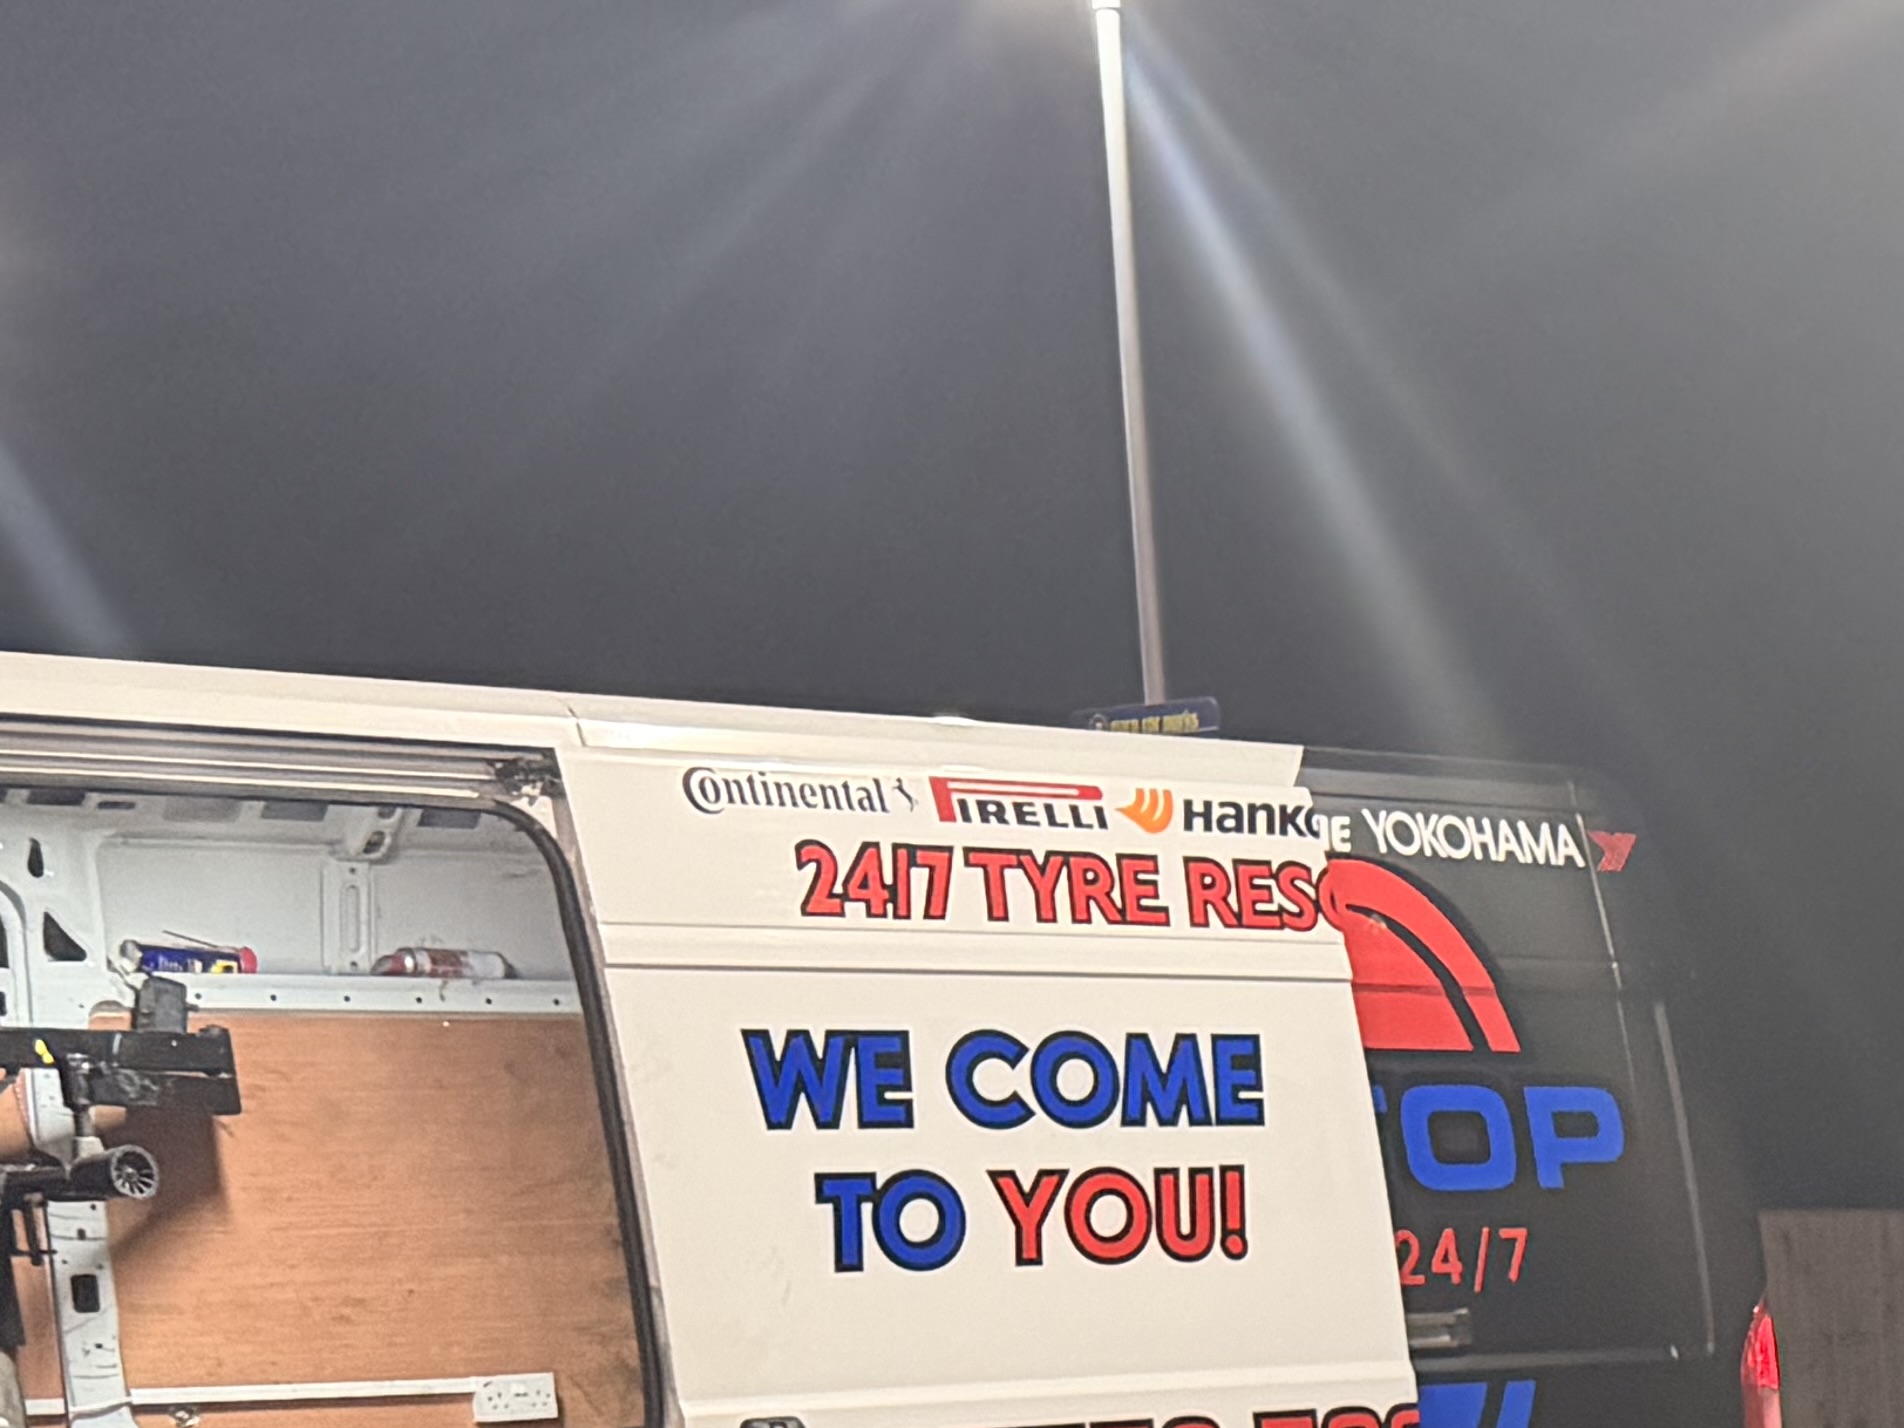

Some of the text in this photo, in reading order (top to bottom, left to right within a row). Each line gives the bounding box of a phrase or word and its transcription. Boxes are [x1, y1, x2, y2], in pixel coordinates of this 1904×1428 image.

[682, 766, 890, 815] Continental
[929, 776, 1109, 830] PIRELLI
[1361, 808, 1586, 868] YOKOHAMA
[963, 847, 1170, 927] TYRE
[741, 1029, 1265, 1130] WE COME
[1373, 1084, 1624, 1191] OP
[814, 1165, 1248, 1273] TO YOU!
[1395, 1226, 1528, 1293] 24/7
